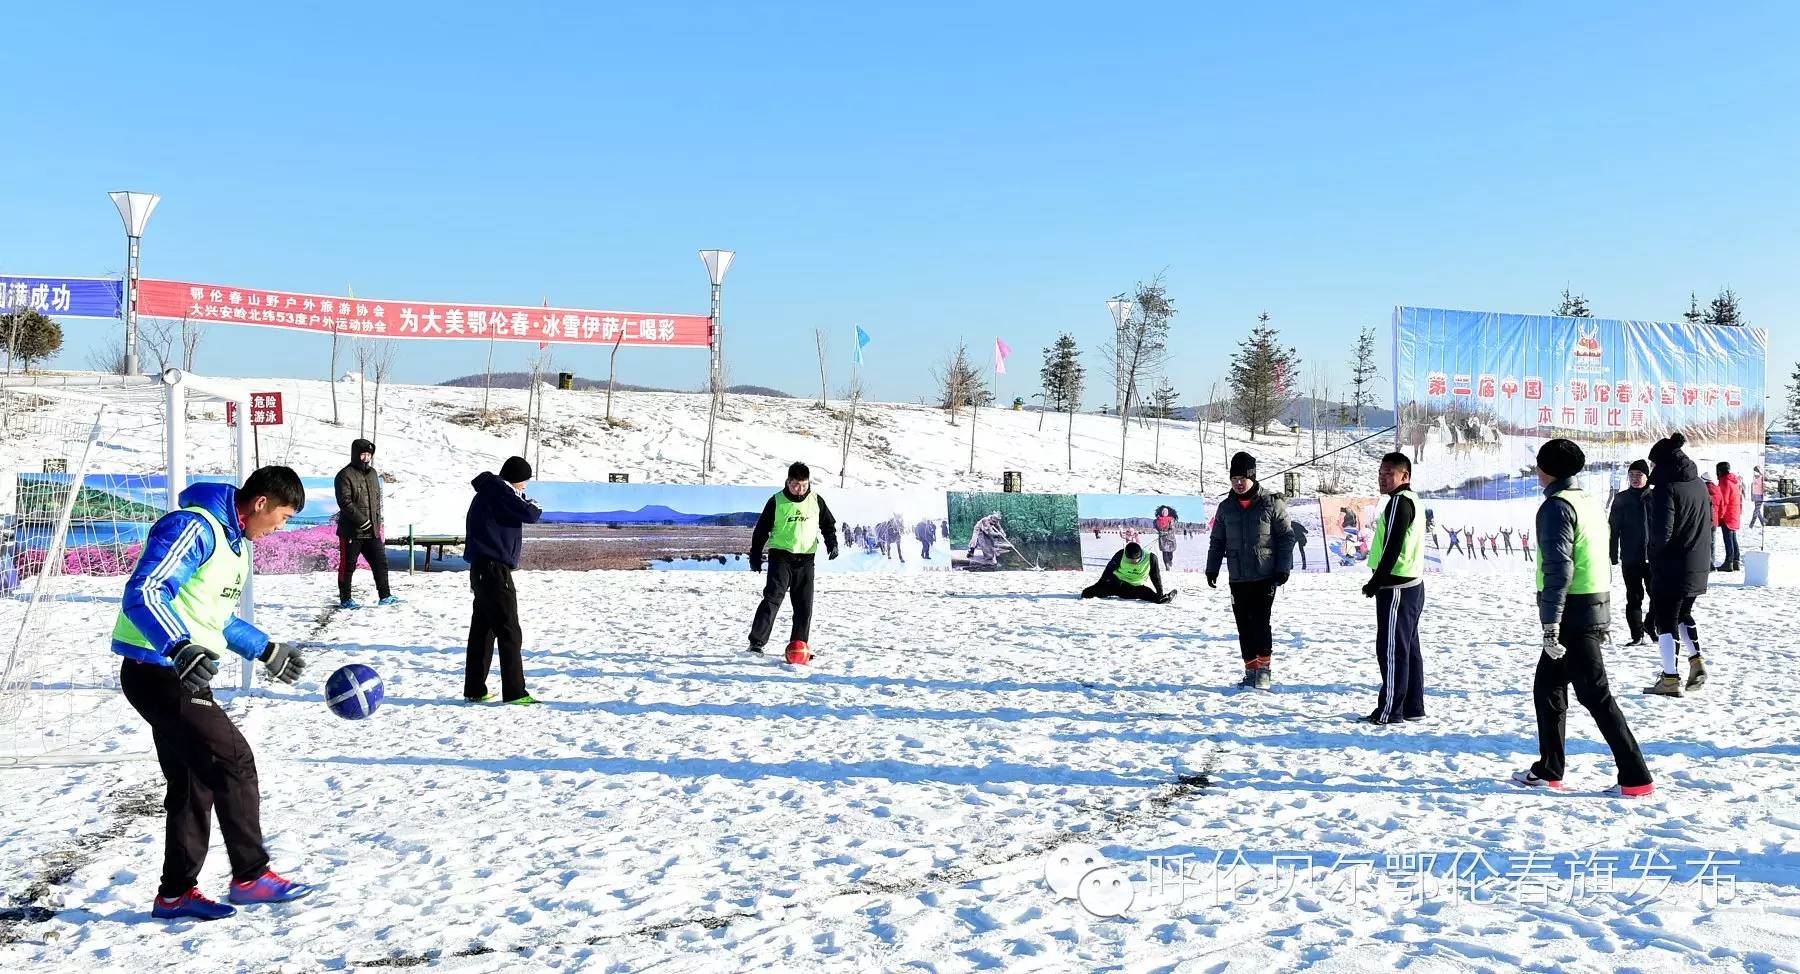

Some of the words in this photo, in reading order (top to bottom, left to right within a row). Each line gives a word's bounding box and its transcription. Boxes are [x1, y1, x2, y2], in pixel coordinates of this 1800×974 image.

[189, 286, 385, 318] 鄂伦春山野户外旅游协会
[190, 302, 387, 333] 大兴安岭北纬53度户外运动协会
[1538, 405, 1644, 427] 本布利比赛
